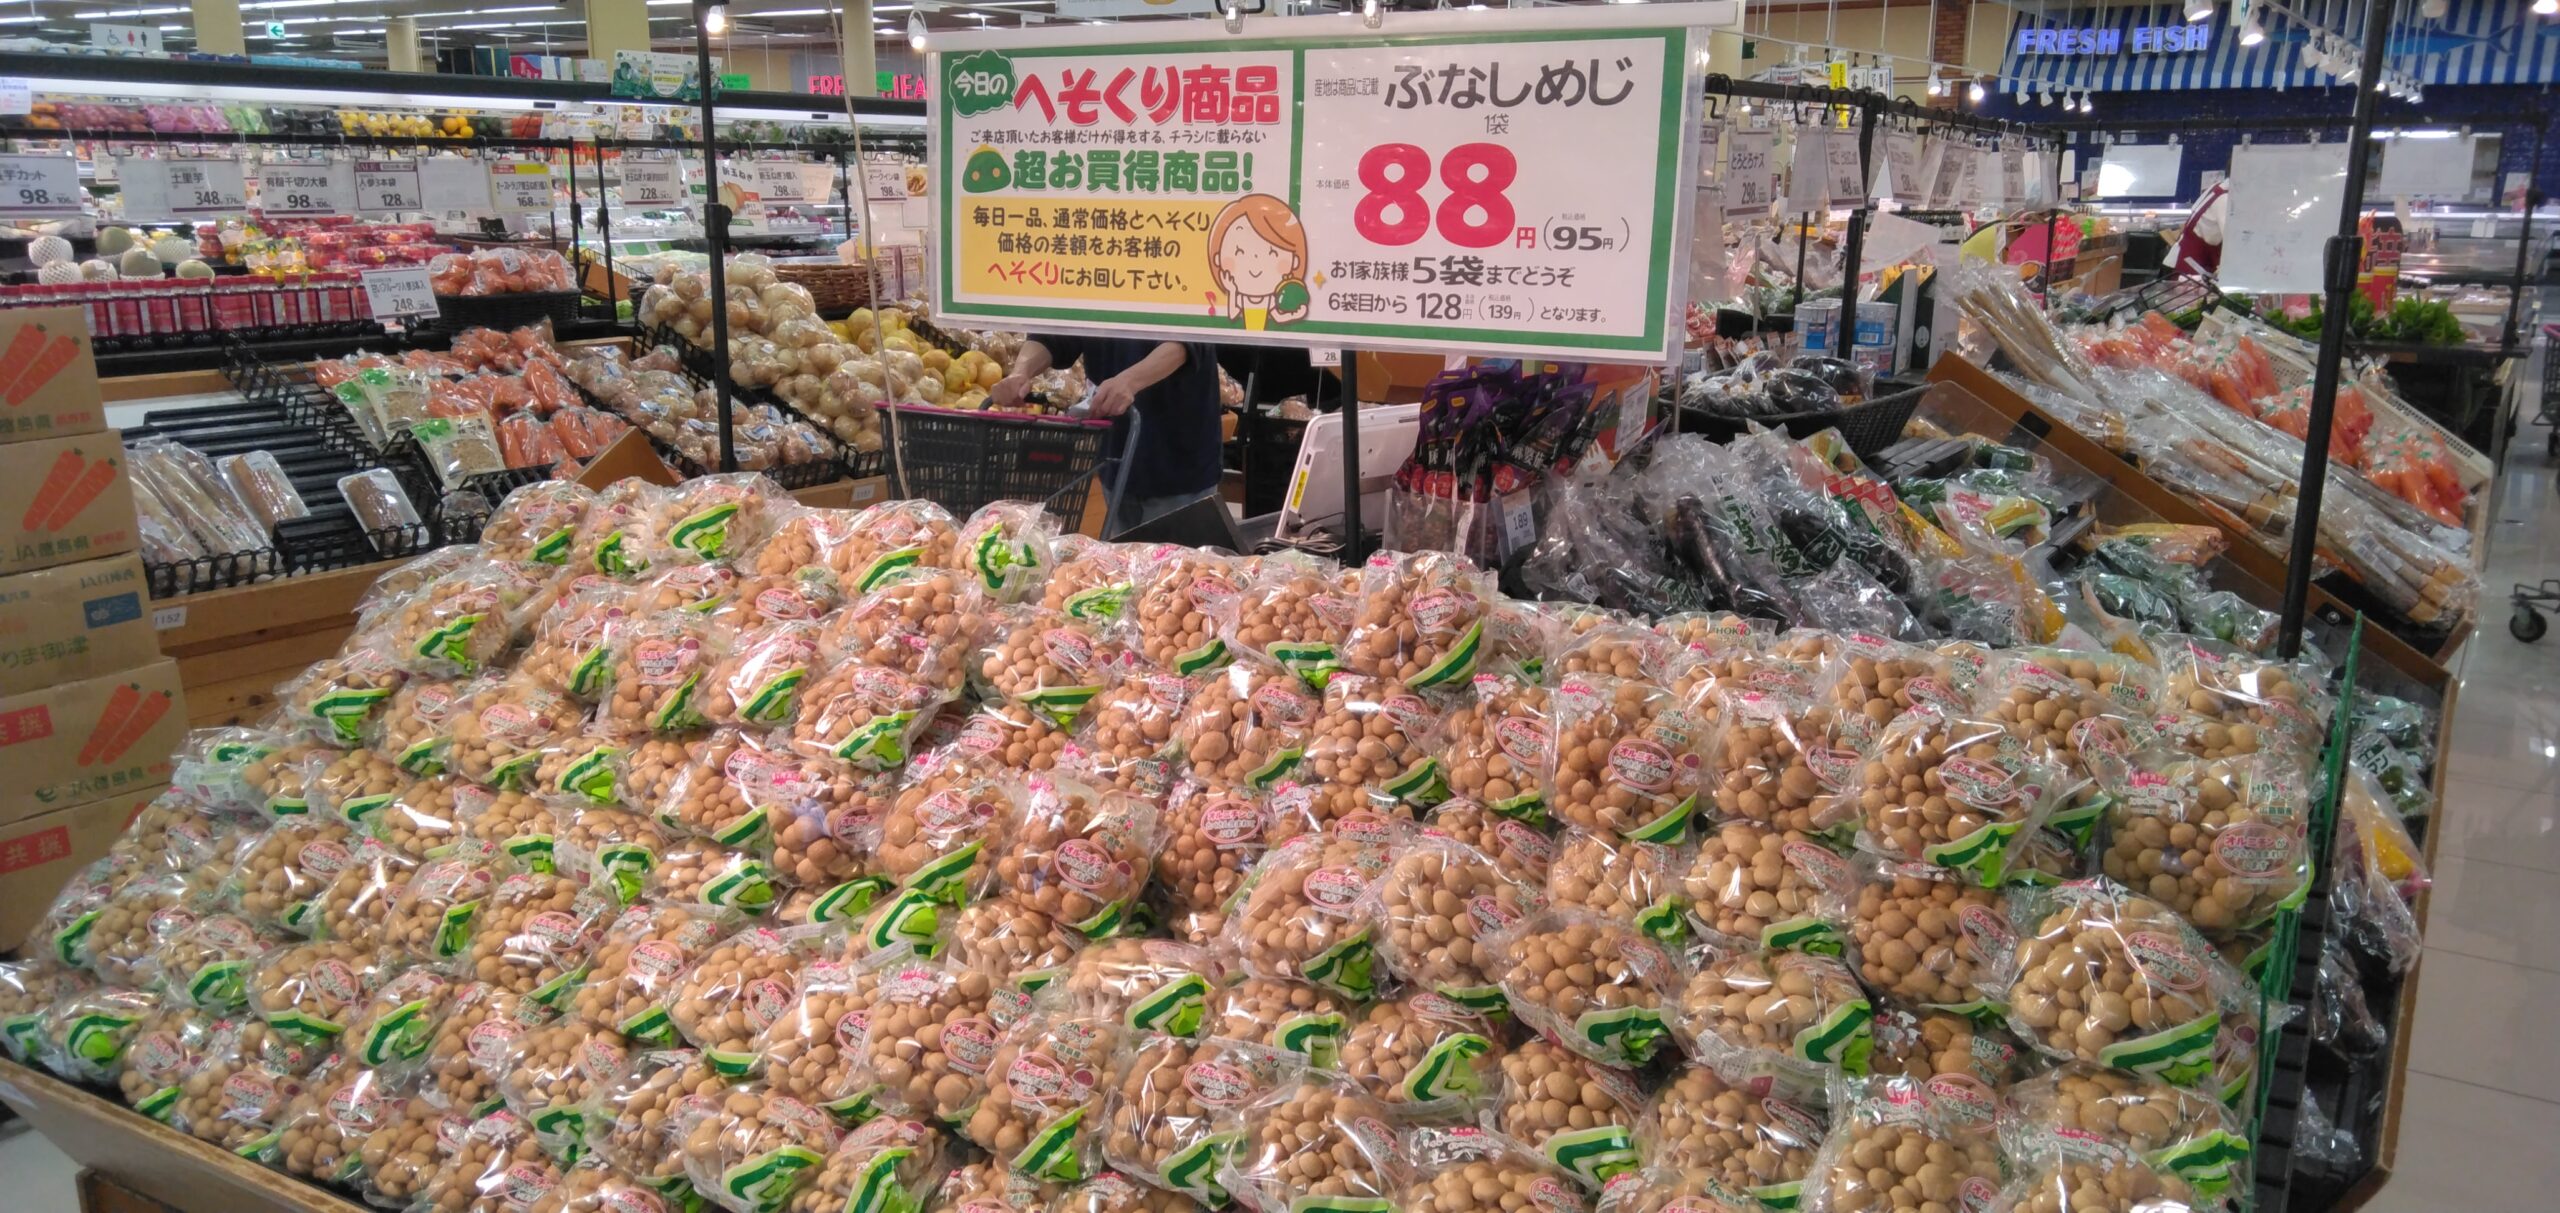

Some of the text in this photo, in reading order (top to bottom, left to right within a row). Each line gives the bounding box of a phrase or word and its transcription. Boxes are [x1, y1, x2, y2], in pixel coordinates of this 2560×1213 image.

[2018, 24, 2209, 55] FRESH FISH
[809, 75, 846, 96] FRE
[954, 68, 1007, 97] 今日の
[1313, 78, 1379, 97] 産地は商品に記載
[1384, 57, 1634, 109] ぶなしめじ
[1013, 64, 1281, 126] へそくり商品
[1484, 114, 1509, 135] 1袋
[970, 129, 1267, 145] ご来店頂いたお客様だけが得をする、チラシに載らない
[1012, 149, 1254, 192] 超お買得商品!
[640, 187, 657, 200] 228
[773, 185, 788, 197] 298
[1316, 179, 1350, 190] 本体価格
[1742, 182, 1756, 205] 298
[19, 189, 50, 204] 98
[195, 191, 221, 206] 348
[287, 194, 310, 209] 98
[381, 193, 402, 207] 128
[973, 205, 1211, 232] 毎日一品、通常価格とへそくり
[997, 232, 1181, 258] 価格の差額をお客様の
[987, 259, 1190, 292] へそくりにお回し下さい。
[392, 298, 414, 312] 248
[1512, 513, 1528, 530] 189
